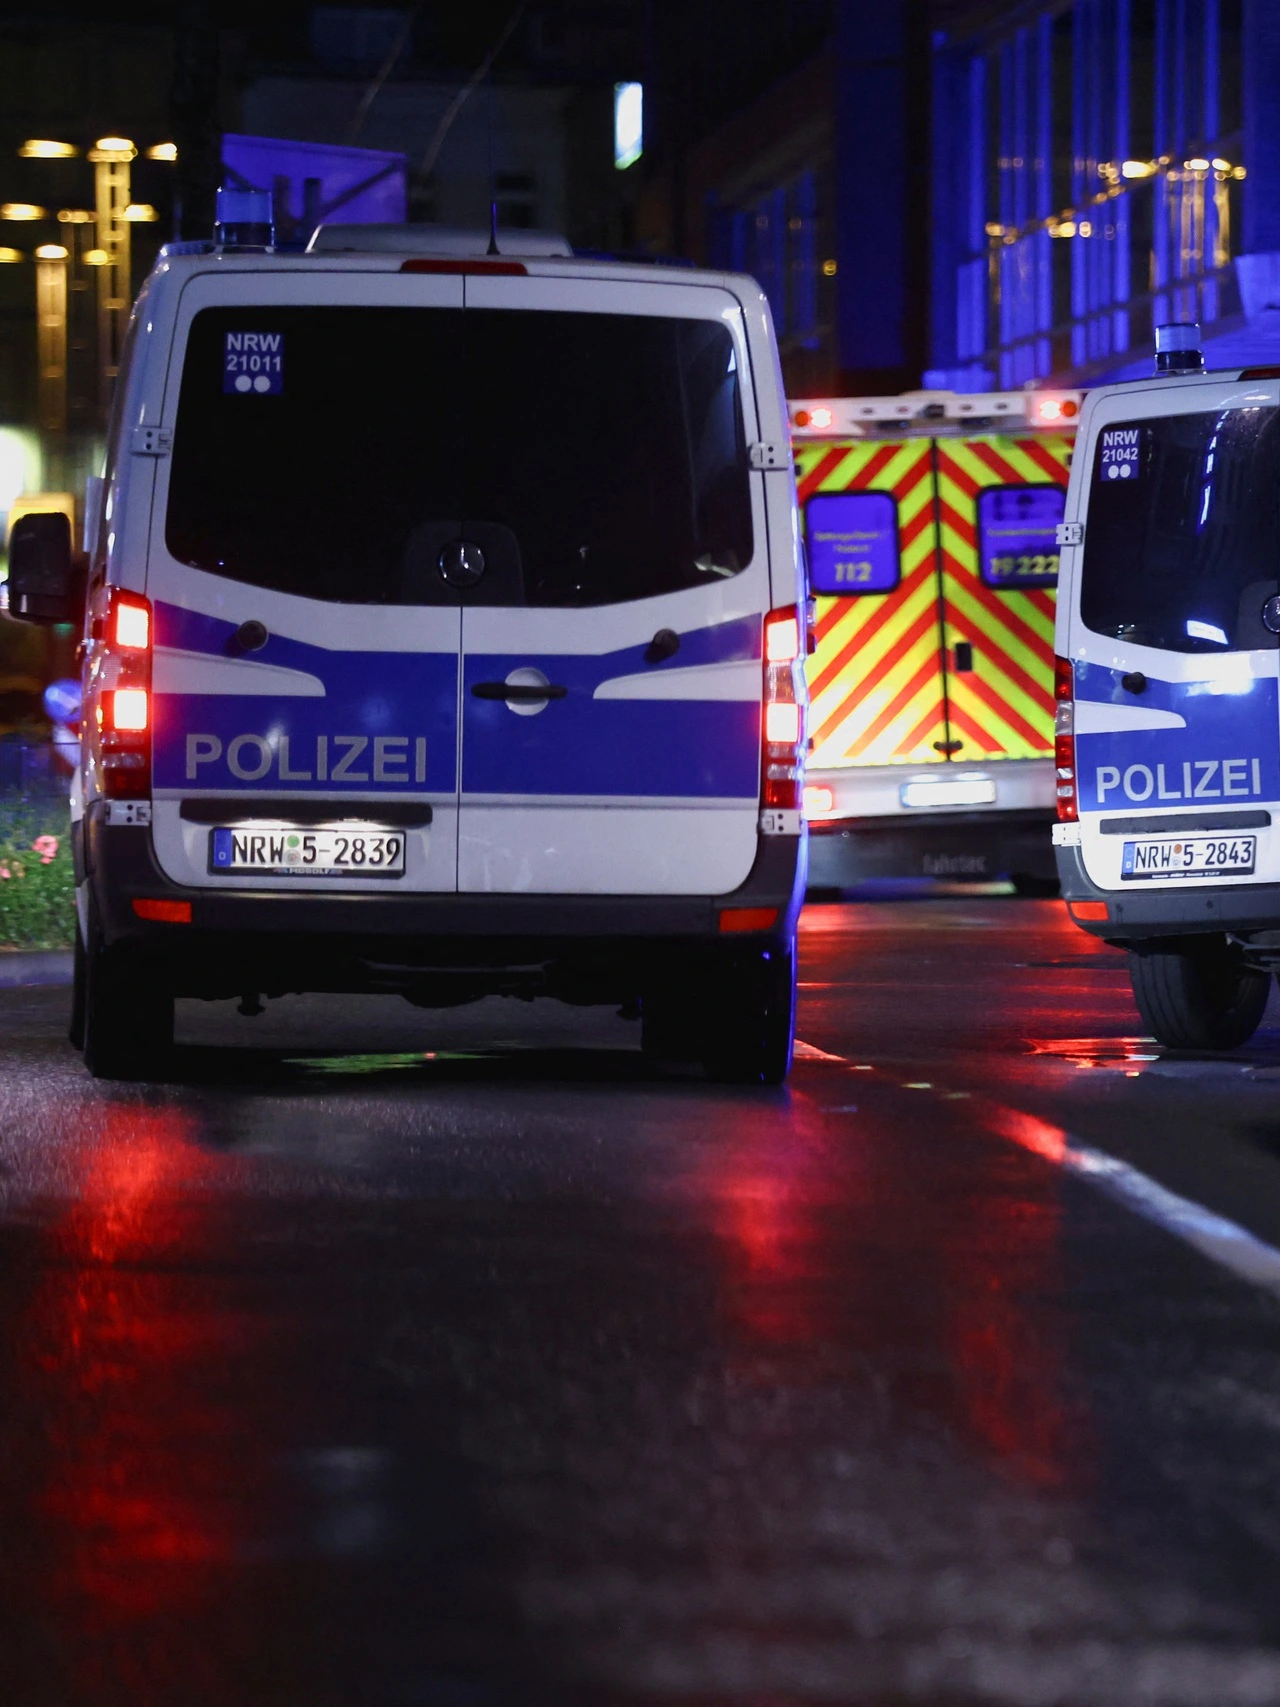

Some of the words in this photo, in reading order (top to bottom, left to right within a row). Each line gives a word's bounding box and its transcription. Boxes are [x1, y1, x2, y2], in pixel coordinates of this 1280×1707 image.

[227, 333, 281, 352] NRW
[226, 354, 281, 372] 21011
[1103, 429, 1138, 447] NRW
[1102, 447, 1138, 463] 21042
[834, 561, 873, 582] 112
[185, 733, 427, 783] POLIZEI
[1096, 758, 1262, 803] POLIZEI
[231, 835, 285, 865] NRW
[302, 836, 401, 867] 5-2839
[1135, 845, 1172, 869] NRW
[1183, 841, 1252, 867] 5-2843
[1125, 861, 1132, 869] D
